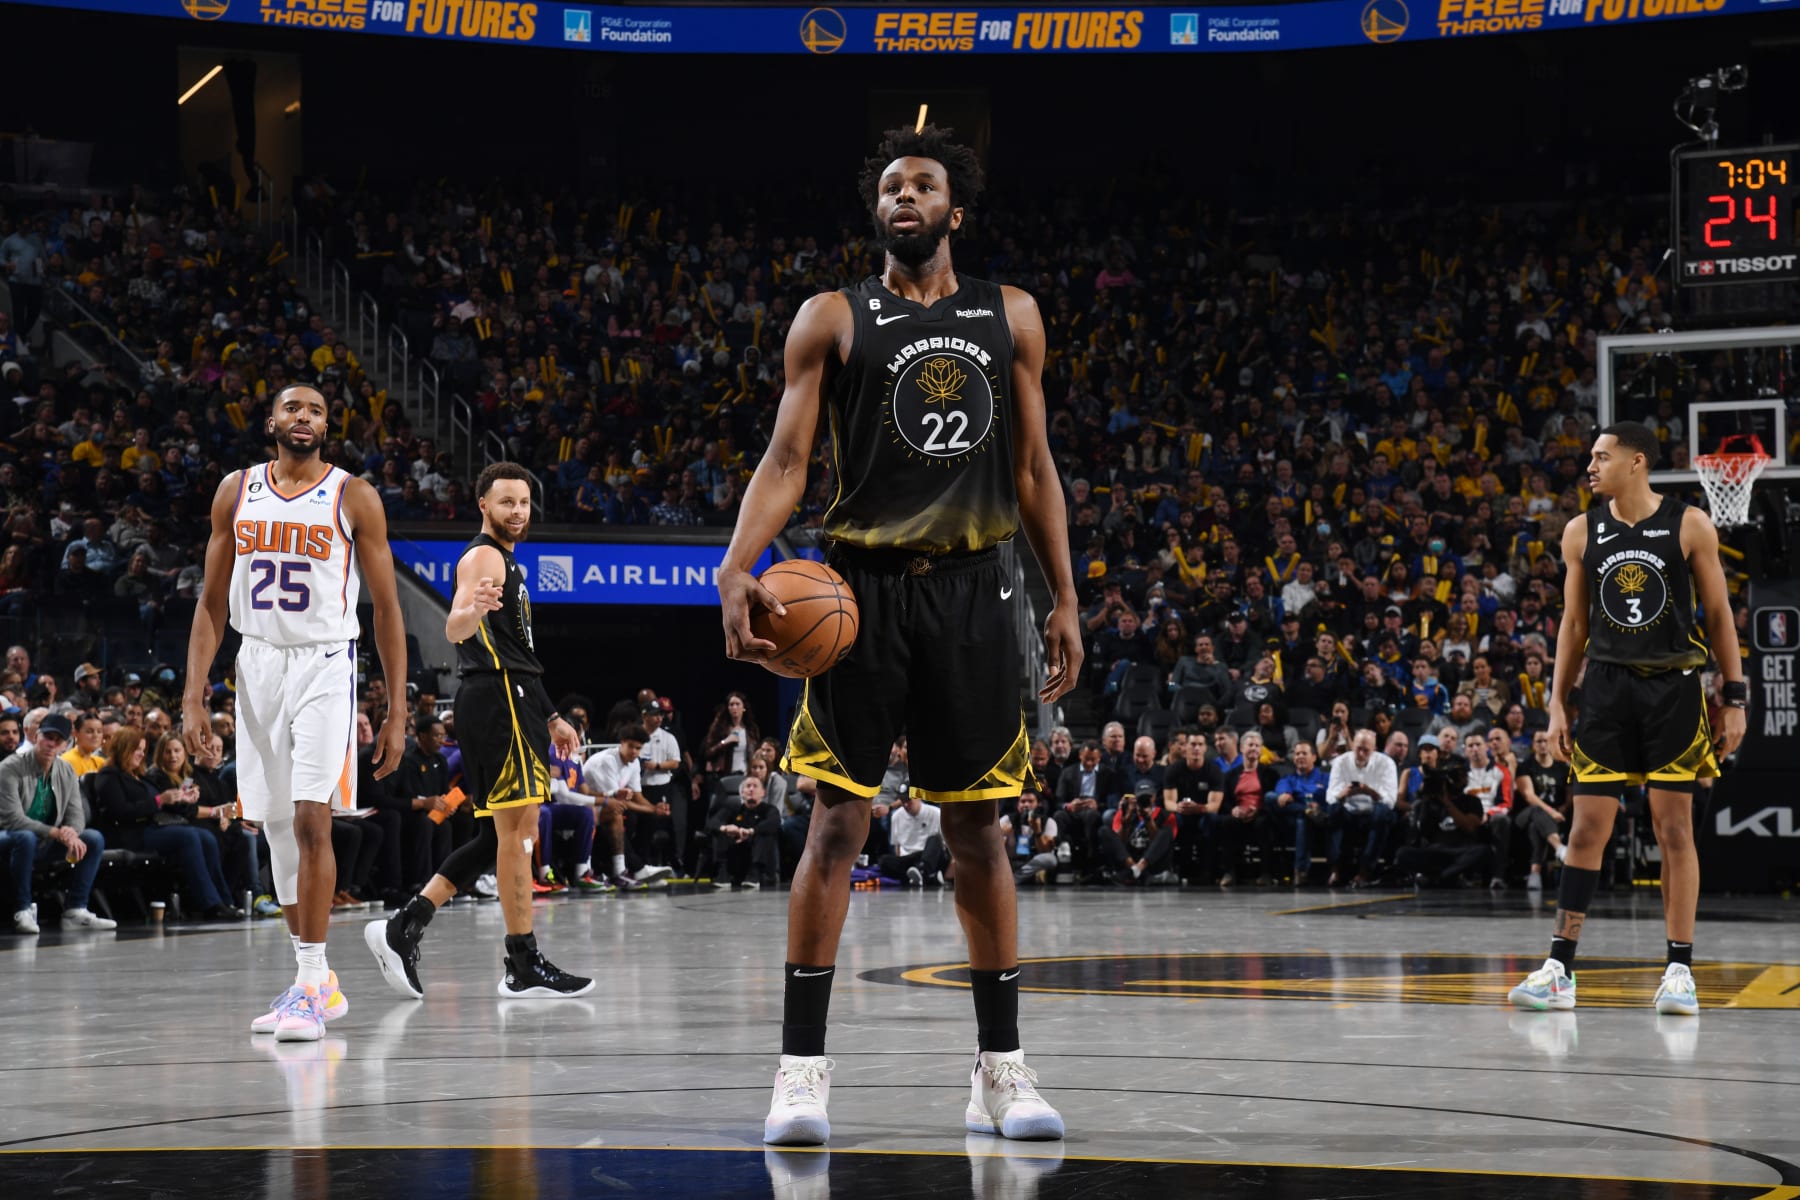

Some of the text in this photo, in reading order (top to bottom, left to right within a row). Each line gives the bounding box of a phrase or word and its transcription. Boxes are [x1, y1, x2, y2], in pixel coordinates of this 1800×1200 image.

[260, 8, 365, 29] THROWS
[371, 0, 537, 40] FOR FUTURES
[1438, 0, 1545, 20] FREE
[625, 18, 671, 29] Corporation
[875, 12, 978, 36] FREE
[979, 11, 1144, 49] FOR FUTURES
[1232, 18, 1279, 27] Corporation
[1437, 14, 1542, 36] THROWS
[601, 27, 672, 42] Foundation
[874, 37, 974, 52] THROWS
[1208, 28, 1280, 42] Foundation
[1718, 159, 1787, 189] 7:04
[1704, 195, 1777, 248] 24
[1716, 255, 1797, 274] TISSOT
[869, 299, 882, 311] 6
[955, 308, 994, 319] Rakuten
[886, 336, 992, 374] WARRIORS
[921, 410, 971, 451] 22
[250, 483, 261, 493] 6
[309, 498, 332, 507] PayPal
[1597, 522, 1606, 534] 6
[1642, 529, 1670, 538] Rakuten
[236, 519, 334, 562] SUNS
[1597, 549, 1666, 574] WARRIORS
[250, 558, 312, 612] 25
[582, 564, 720, 586] AIRLIN
[1625, 597, 1643, 624] 3
[1762, 654, 1795, 681] GET
[1763, 682, 1796, 708] THE
[1764, 710, 1798, 736] APP
